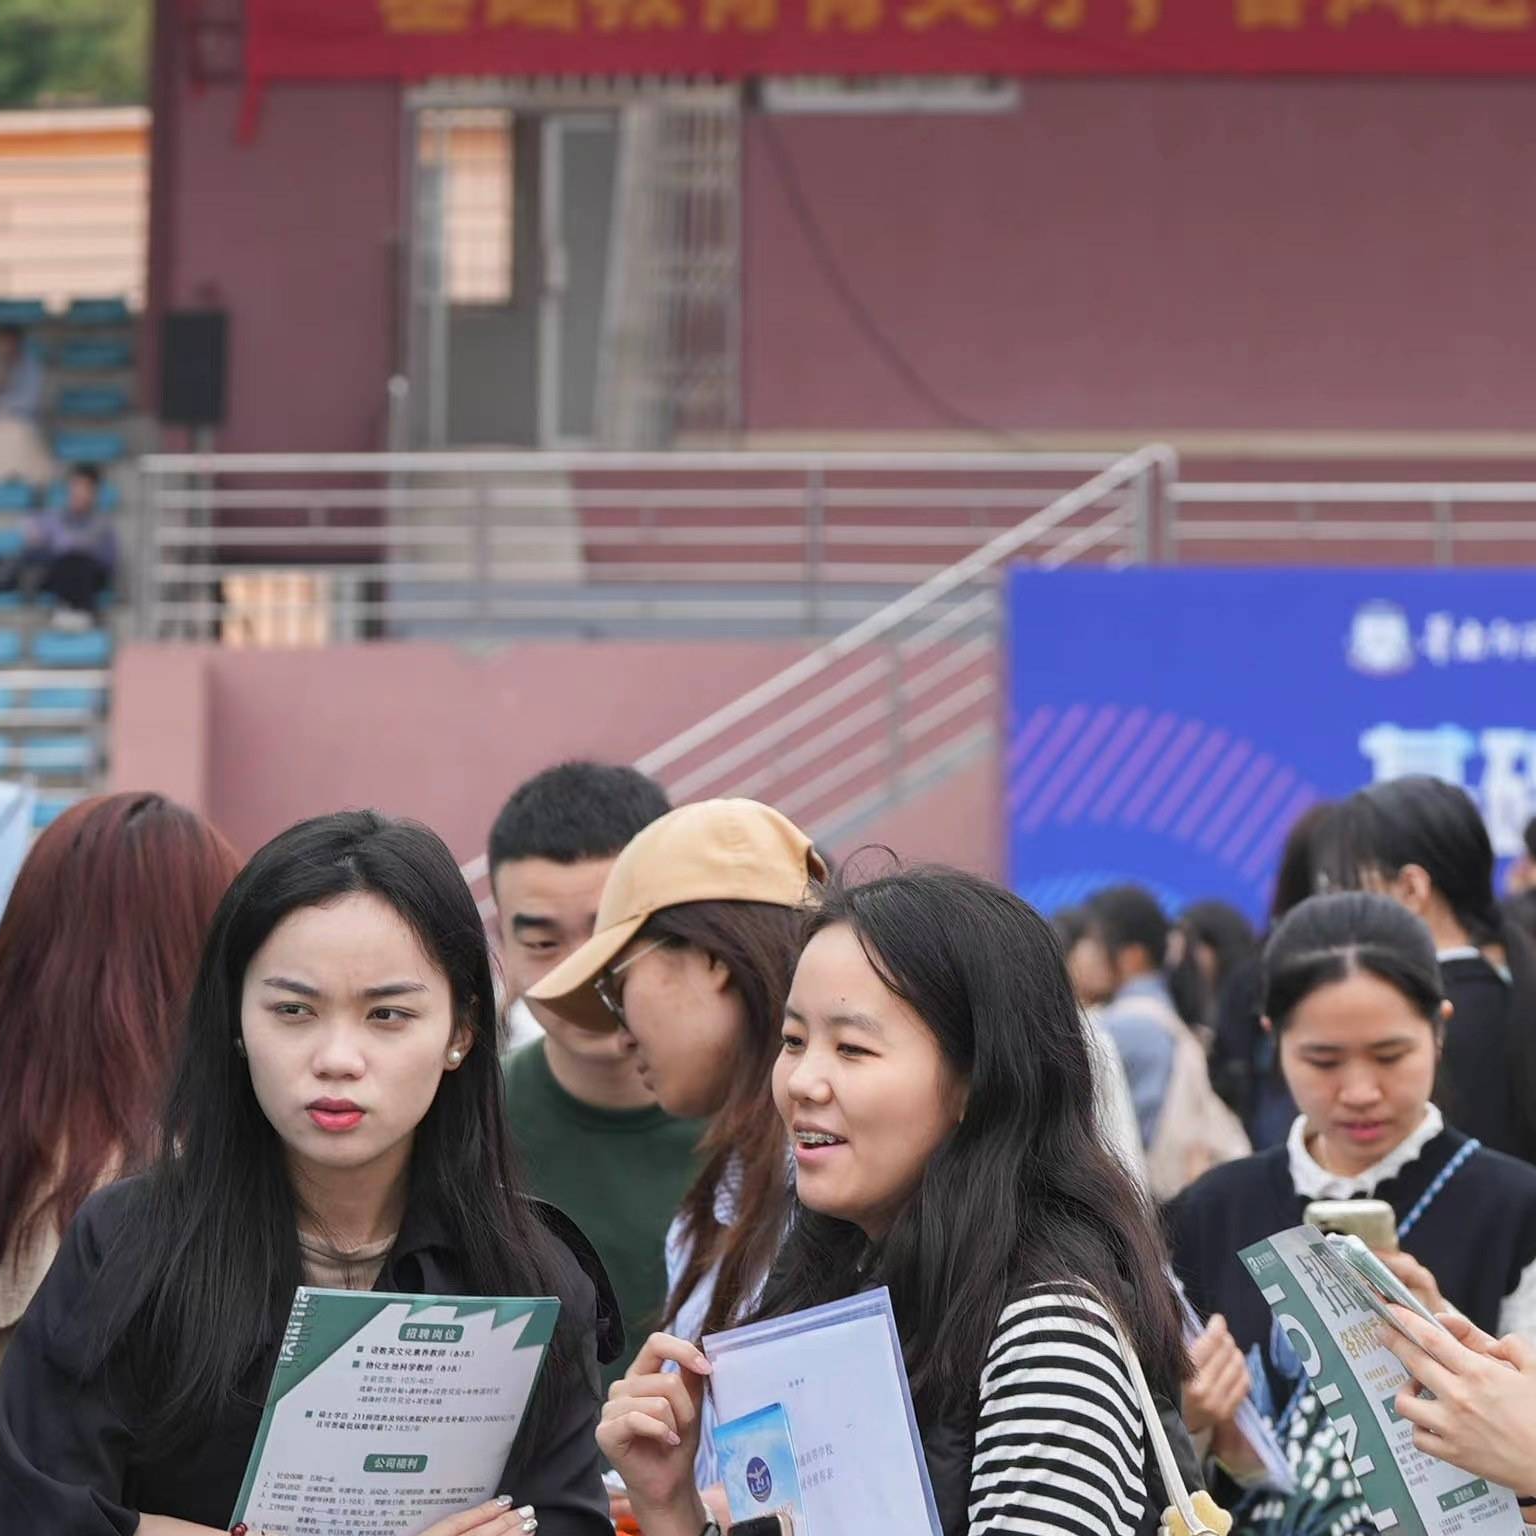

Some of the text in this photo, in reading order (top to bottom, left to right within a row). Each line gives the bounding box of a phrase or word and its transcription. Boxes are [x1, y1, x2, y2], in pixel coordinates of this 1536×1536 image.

[405, 1327, 456, 1341] 招聘岗位
[373, 1457, 418, 1470] 公司福利
